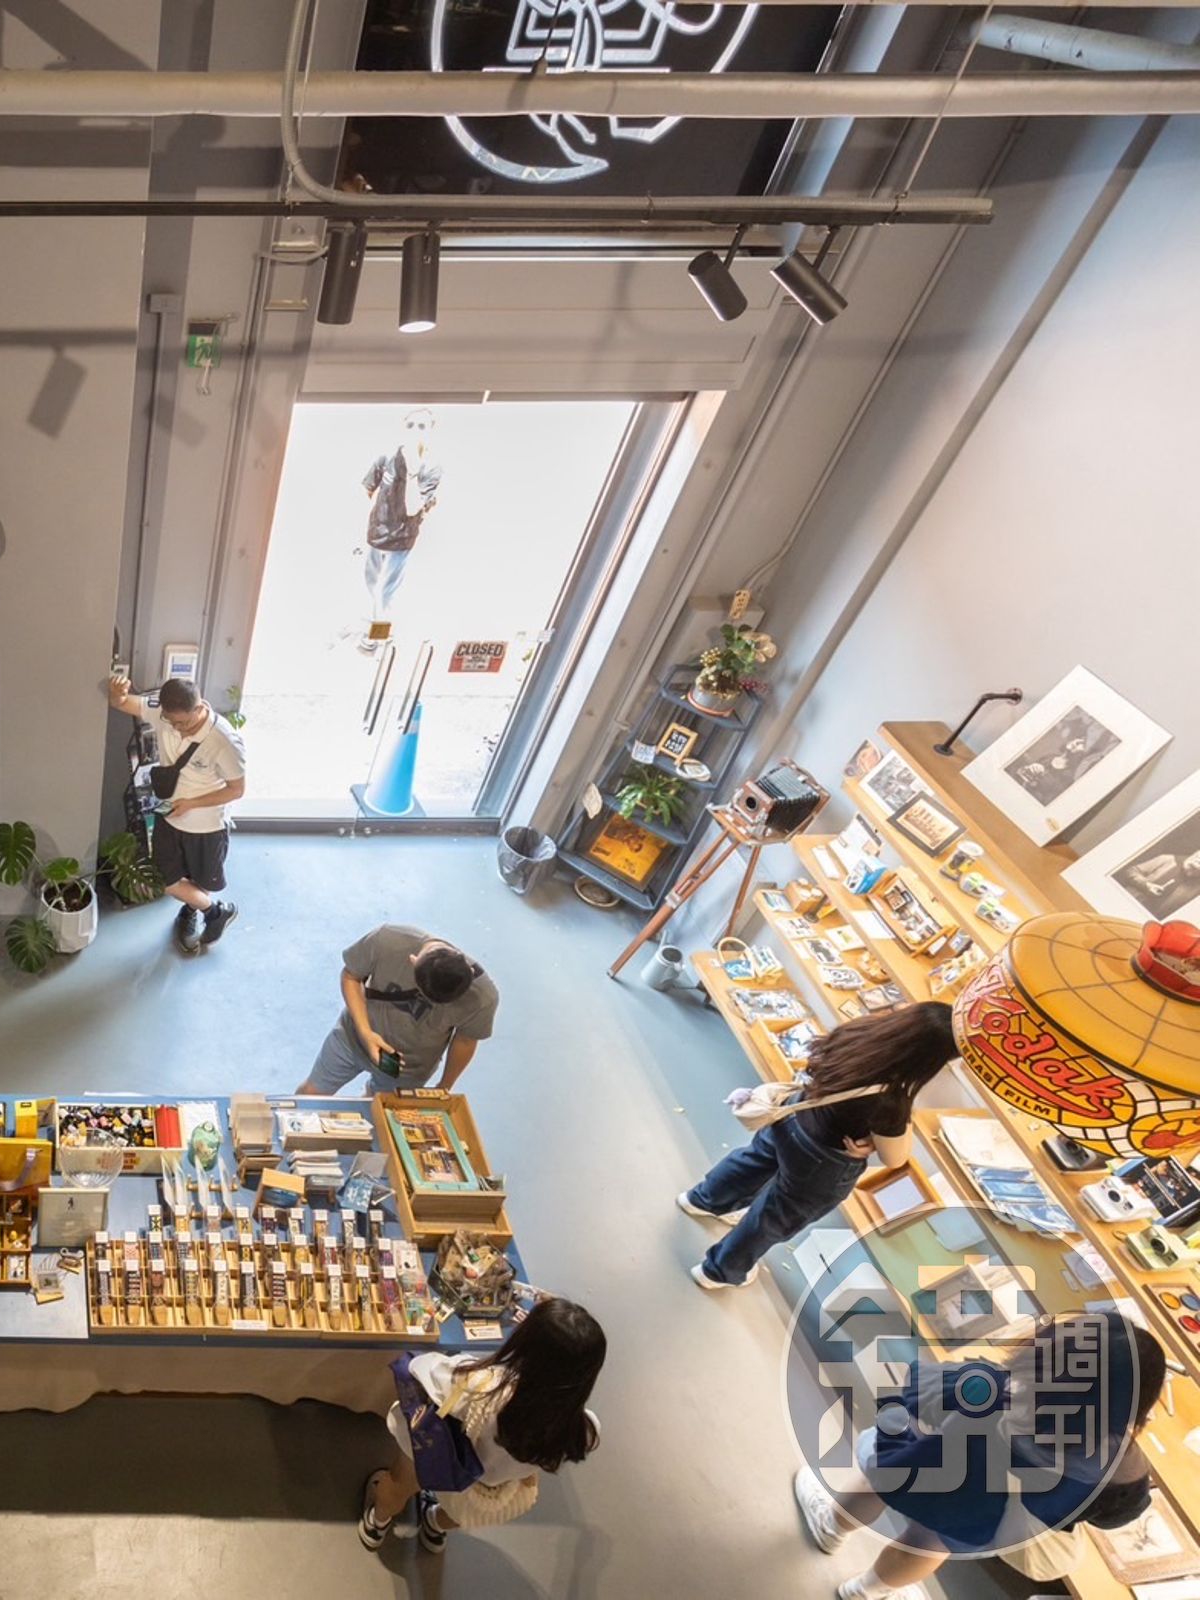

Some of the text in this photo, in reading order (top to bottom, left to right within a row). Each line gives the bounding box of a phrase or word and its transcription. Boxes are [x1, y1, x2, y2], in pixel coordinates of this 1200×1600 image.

[456, 643, 504, 657] CLOSED
[963, 964, 1124, 1121] Kodak
[1004, 1089, 1051, 1116] FILM
